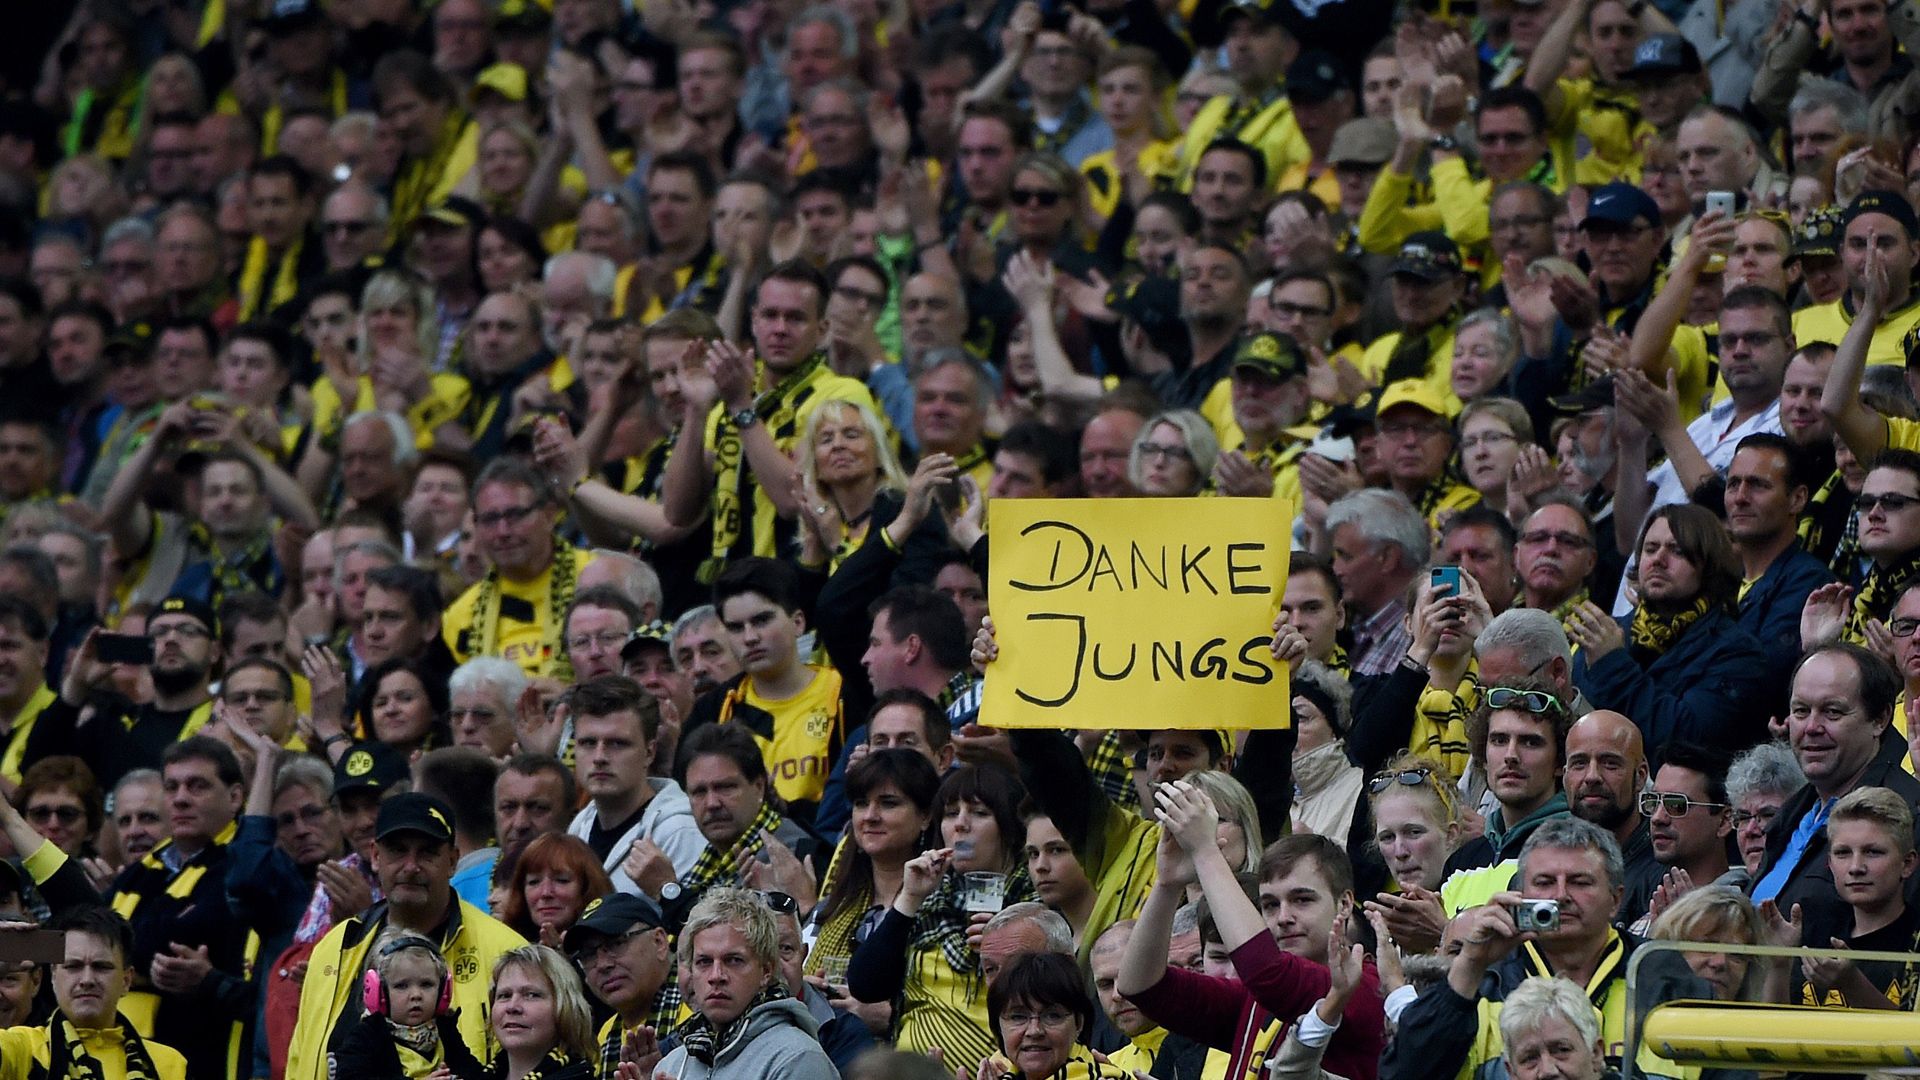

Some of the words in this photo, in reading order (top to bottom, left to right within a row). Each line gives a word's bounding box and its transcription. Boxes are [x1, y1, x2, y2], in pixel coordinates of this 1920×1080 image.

[1009, 520, 1271, 595] DANKE
[1015, 612, 1274, 707] JUNGS
[349, 754, 371, 770] BVB
[455, 957, 477, 976] BVB
